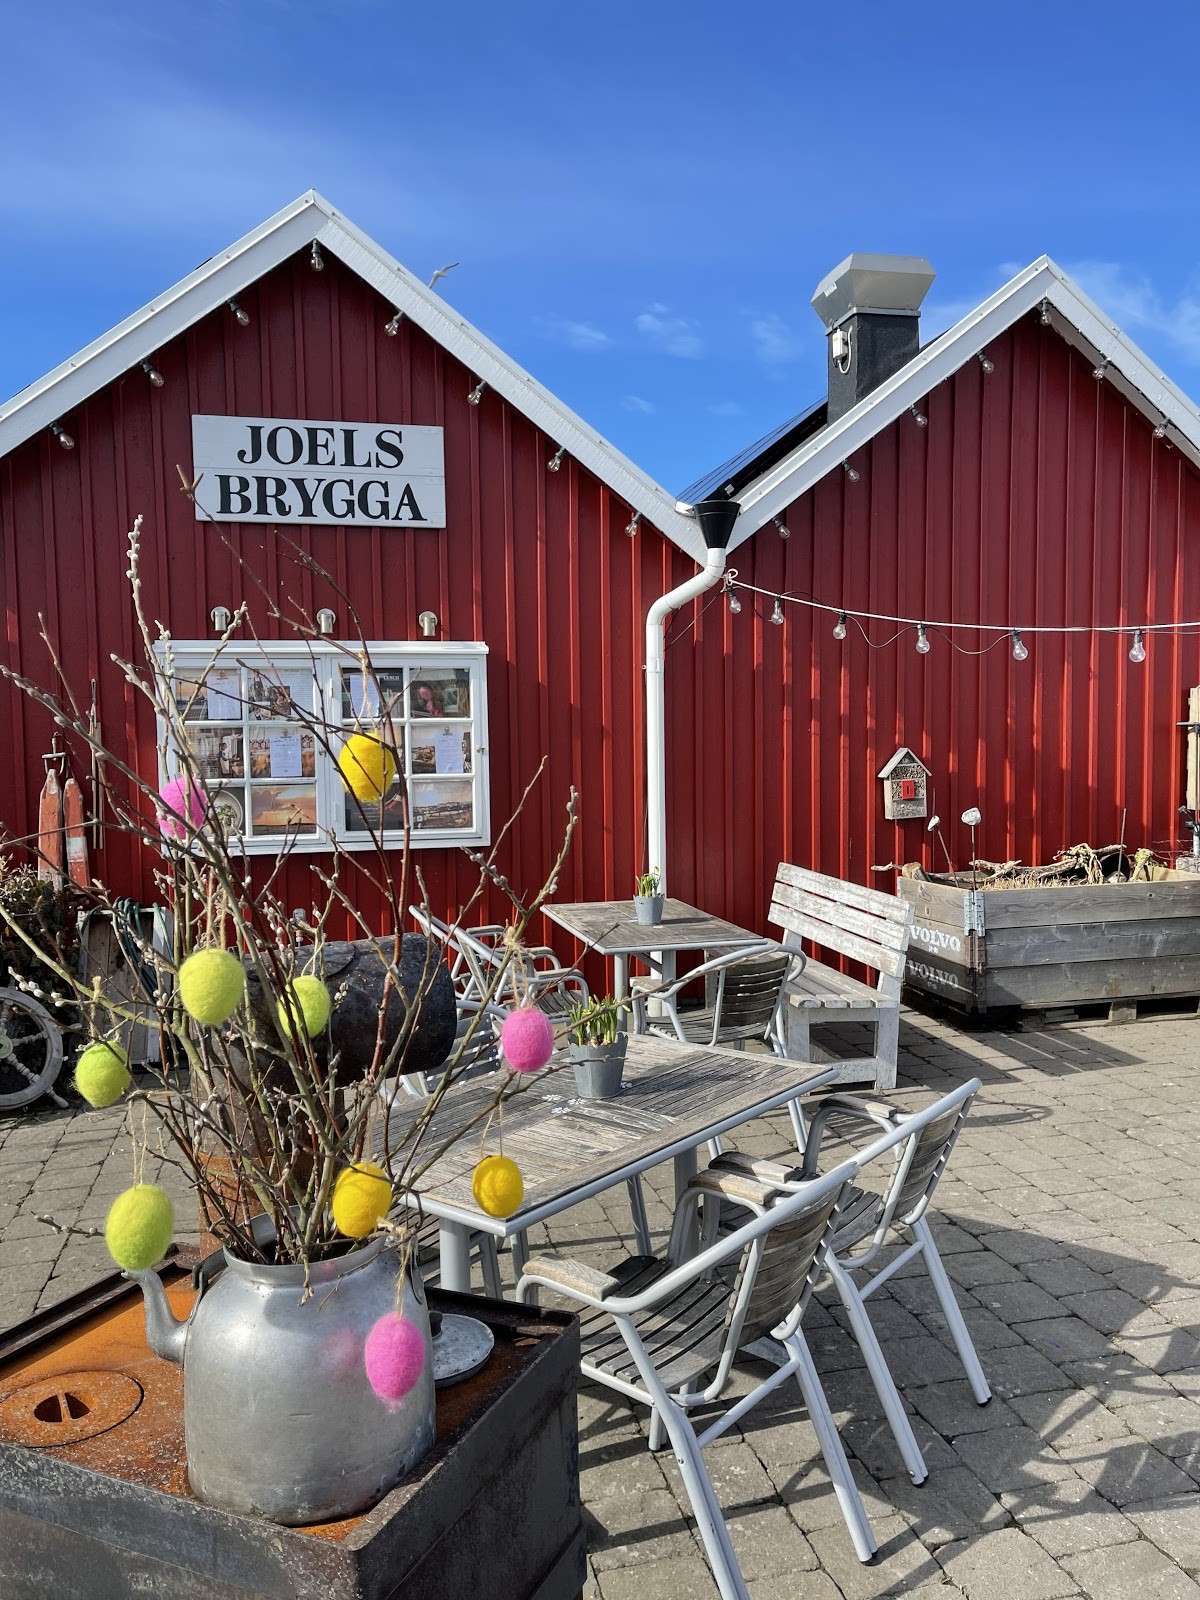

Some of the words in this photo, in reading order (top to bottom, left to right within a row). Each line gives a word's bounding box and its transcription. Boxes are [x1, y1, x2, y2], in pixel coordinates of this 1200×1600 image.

[237, 425, 404, 468] JOELS
[214, 474, 427, 521] BRYGGA
[909, 925, 960, 951] VOLVO
[908, 960, 959, 989] VOLVO
